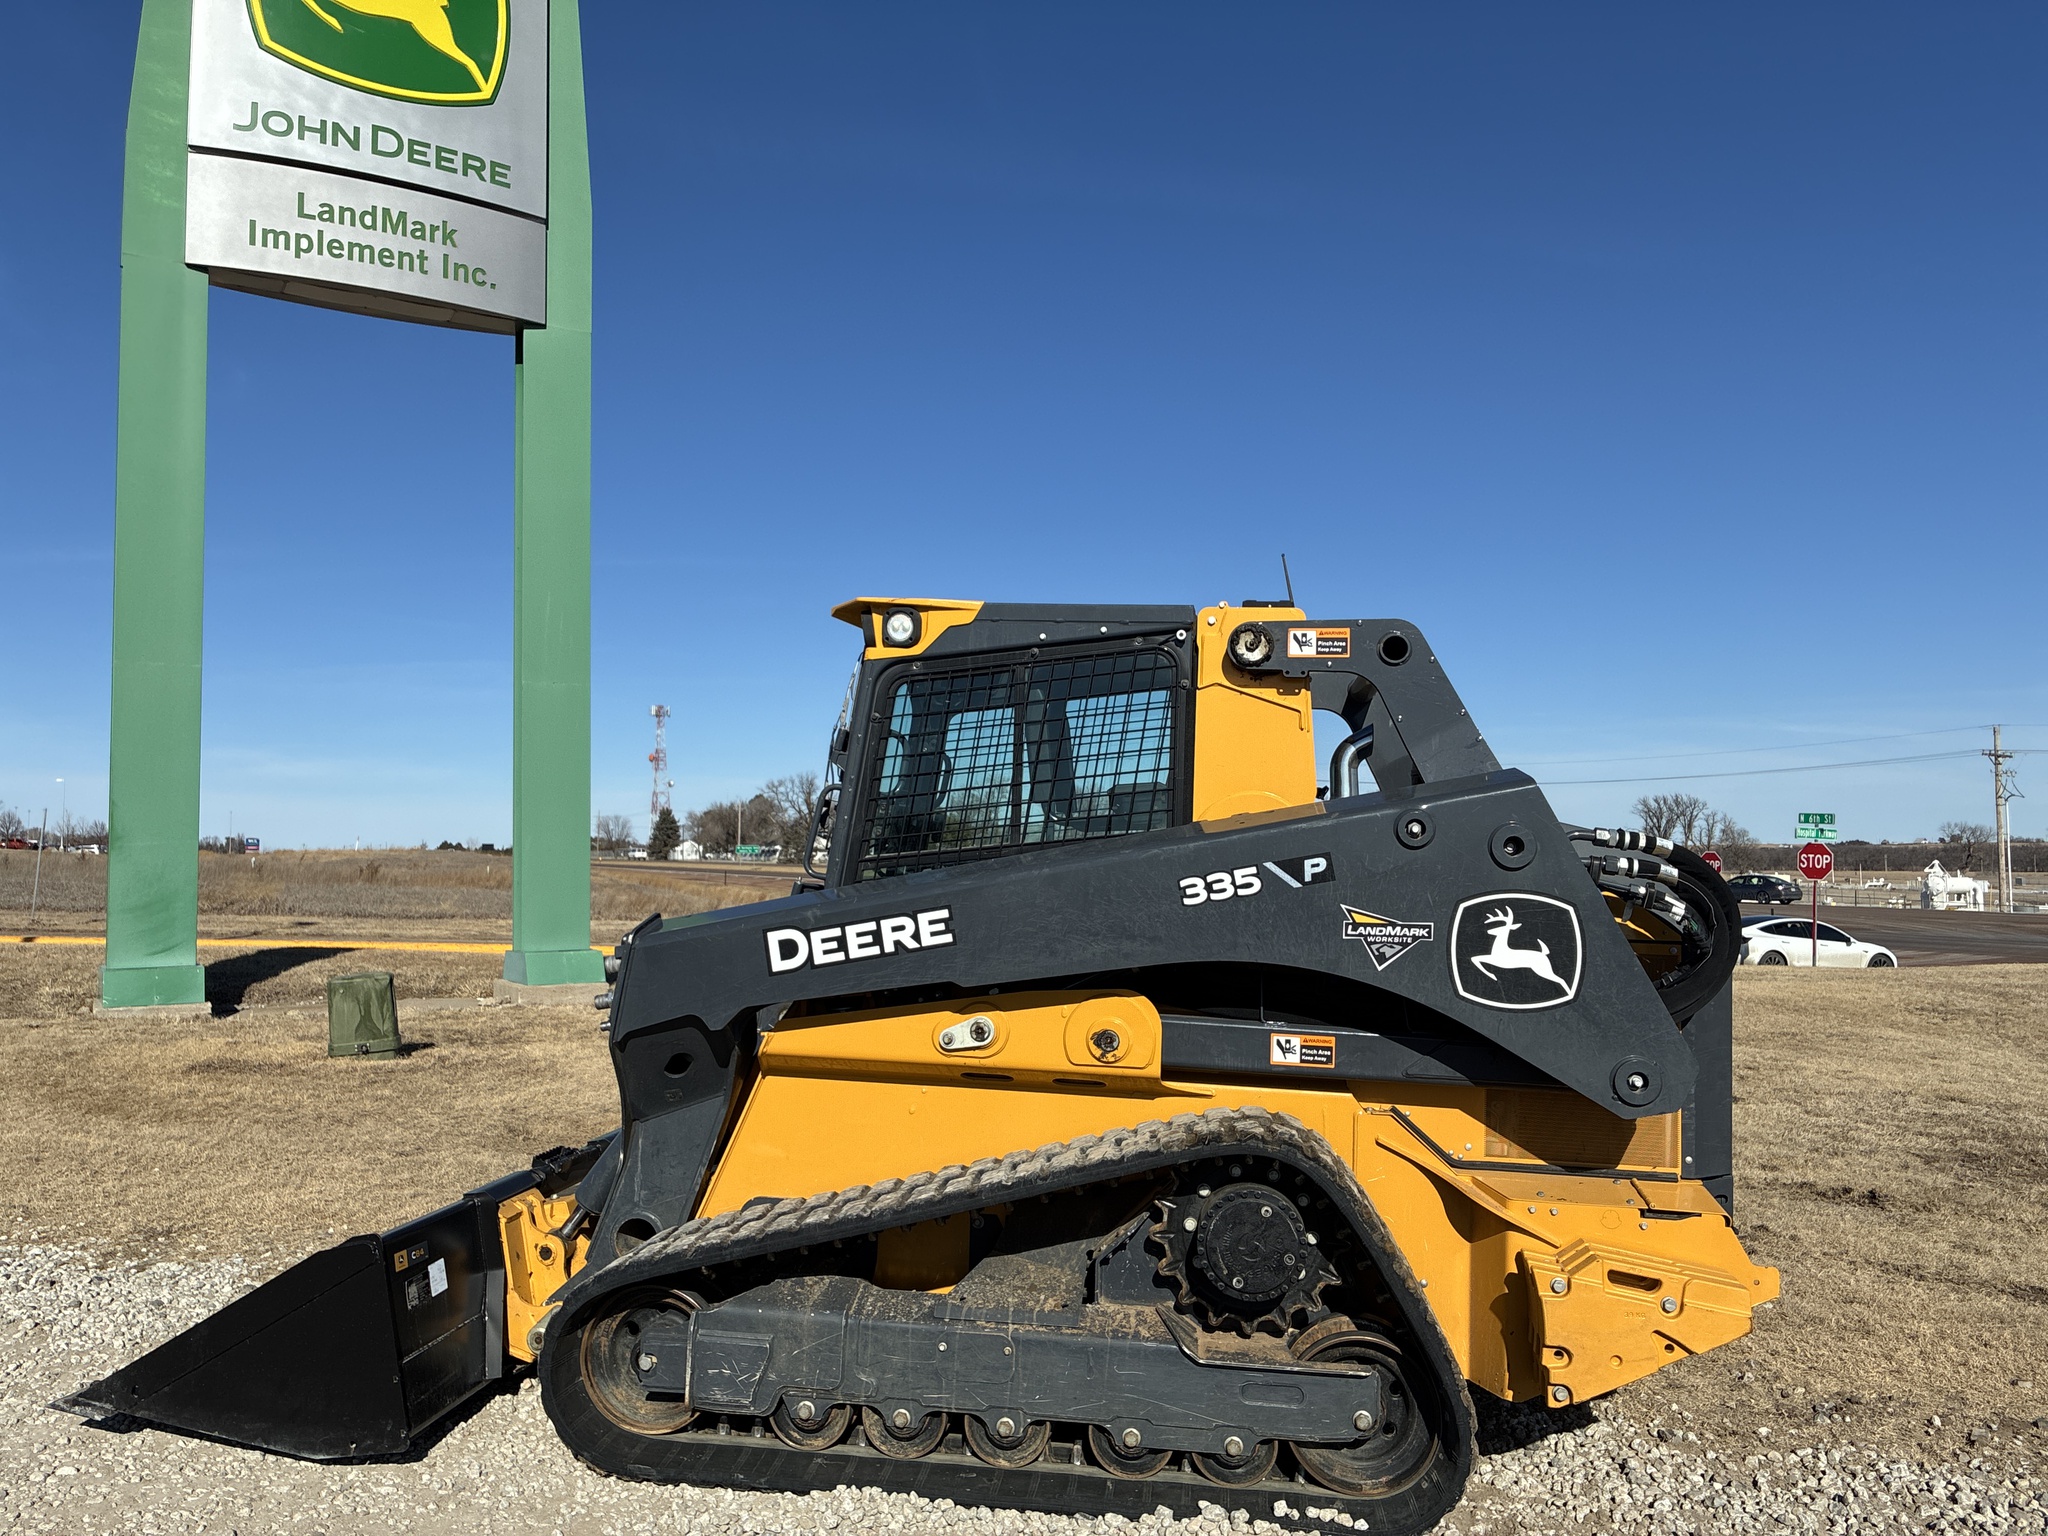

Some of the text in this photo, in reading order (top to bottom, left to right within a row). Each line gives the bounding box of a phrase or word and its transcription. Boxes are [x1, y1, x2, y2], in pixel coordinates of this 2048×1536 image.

[232, 101, 512, 189] JOHN DEERE
[297, 191, 458, 248] LandMark
[249, 219, 497, 290] Implement Inc.
[1800, 814, 1831, 824] N 6th St
[1178, 865, 1263, 907] 335
[1800, 854, 1831, 869] STOP
[766, 908, 954, 973] DEERE
